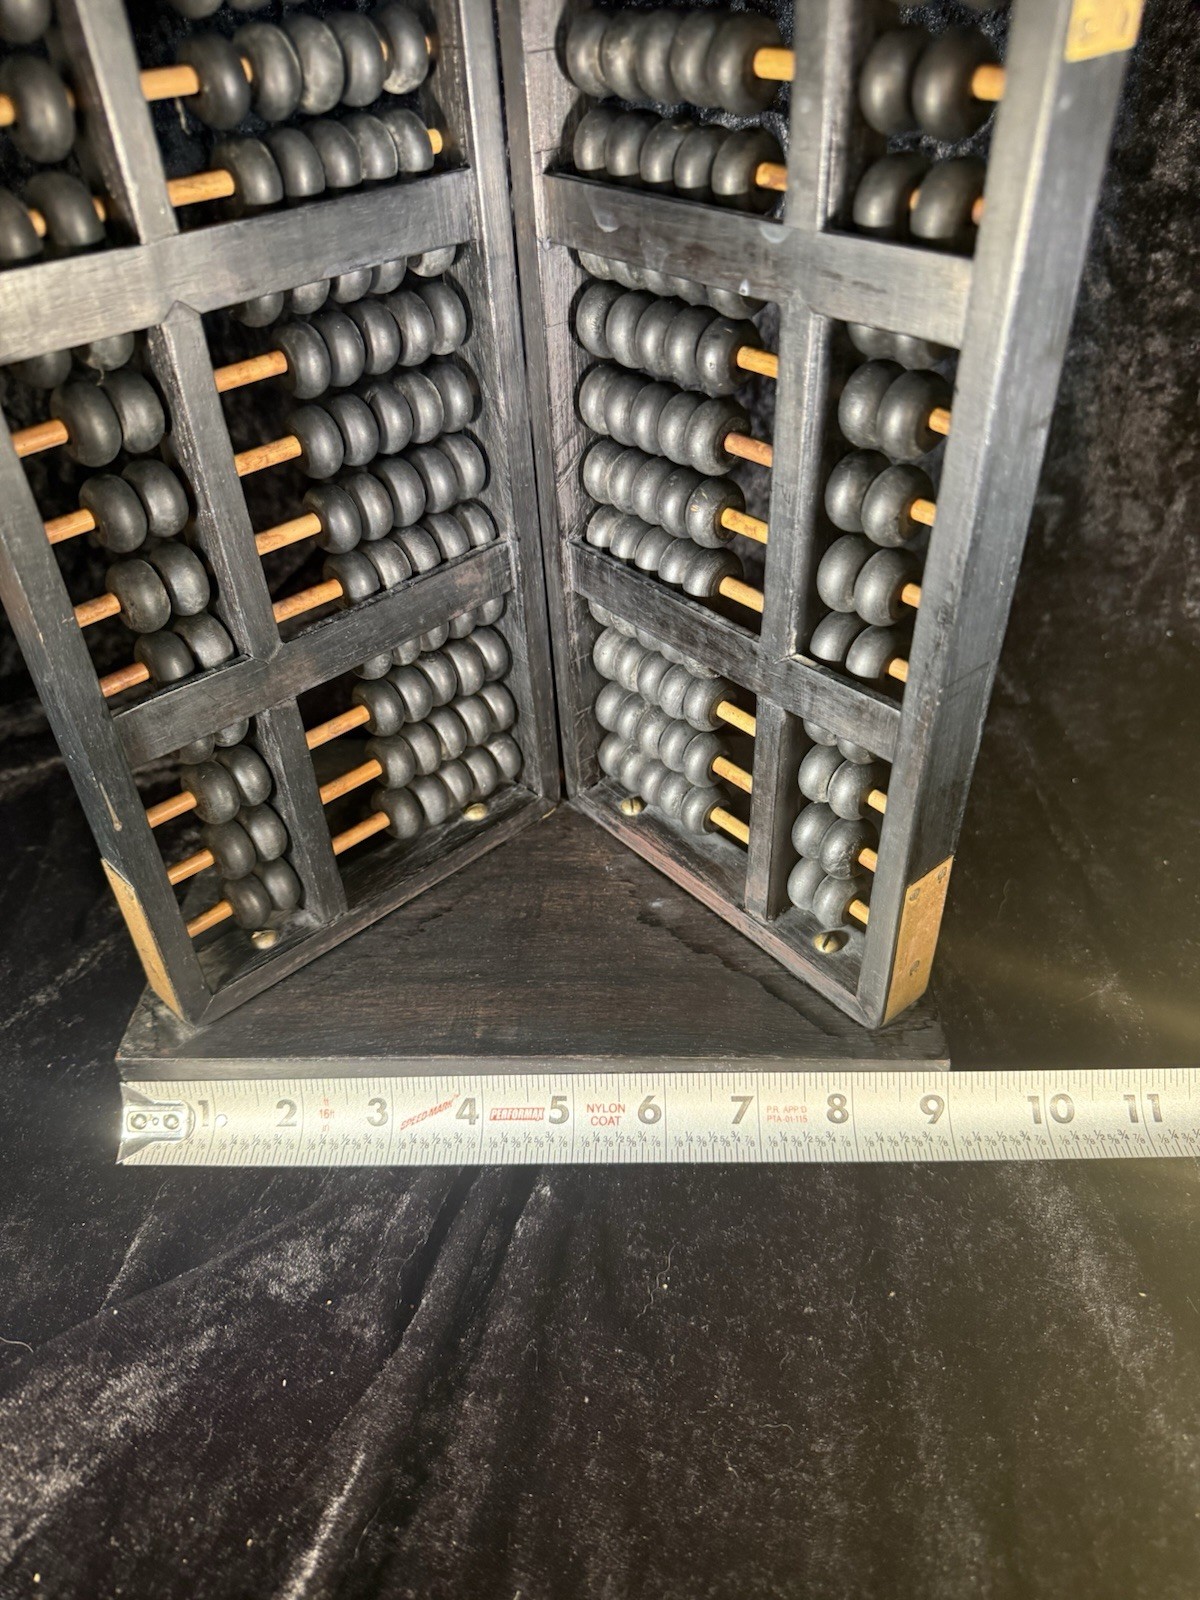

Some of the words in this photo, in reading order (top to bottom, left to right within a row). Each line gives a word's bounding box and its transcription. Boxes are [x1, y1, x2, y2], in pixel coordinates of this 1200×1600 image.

[198, 1100, 210, 1127] 1
[276, 1099, 297, 1127] 2
[366, 1097, 389, 1127] 3
[455, 1097, 479, 1125] 4
[549, 1095, 570, 1125] 5
[638, 1095, 662, 1125] 6
[731, 1096, 754, 1124] 7
[826, 1093, 849, 1124] 8
[919, 1094, 945, 1124] 9
[1027, 1093, 1075, 1124] 10
[1123, 1093, 1163, 1123] 11
[489, 1107, 545, 1121] PERFORMAX
[586, 1103, 626, 1113] NYLON
[590, 1116, 622, 1126] COAT
